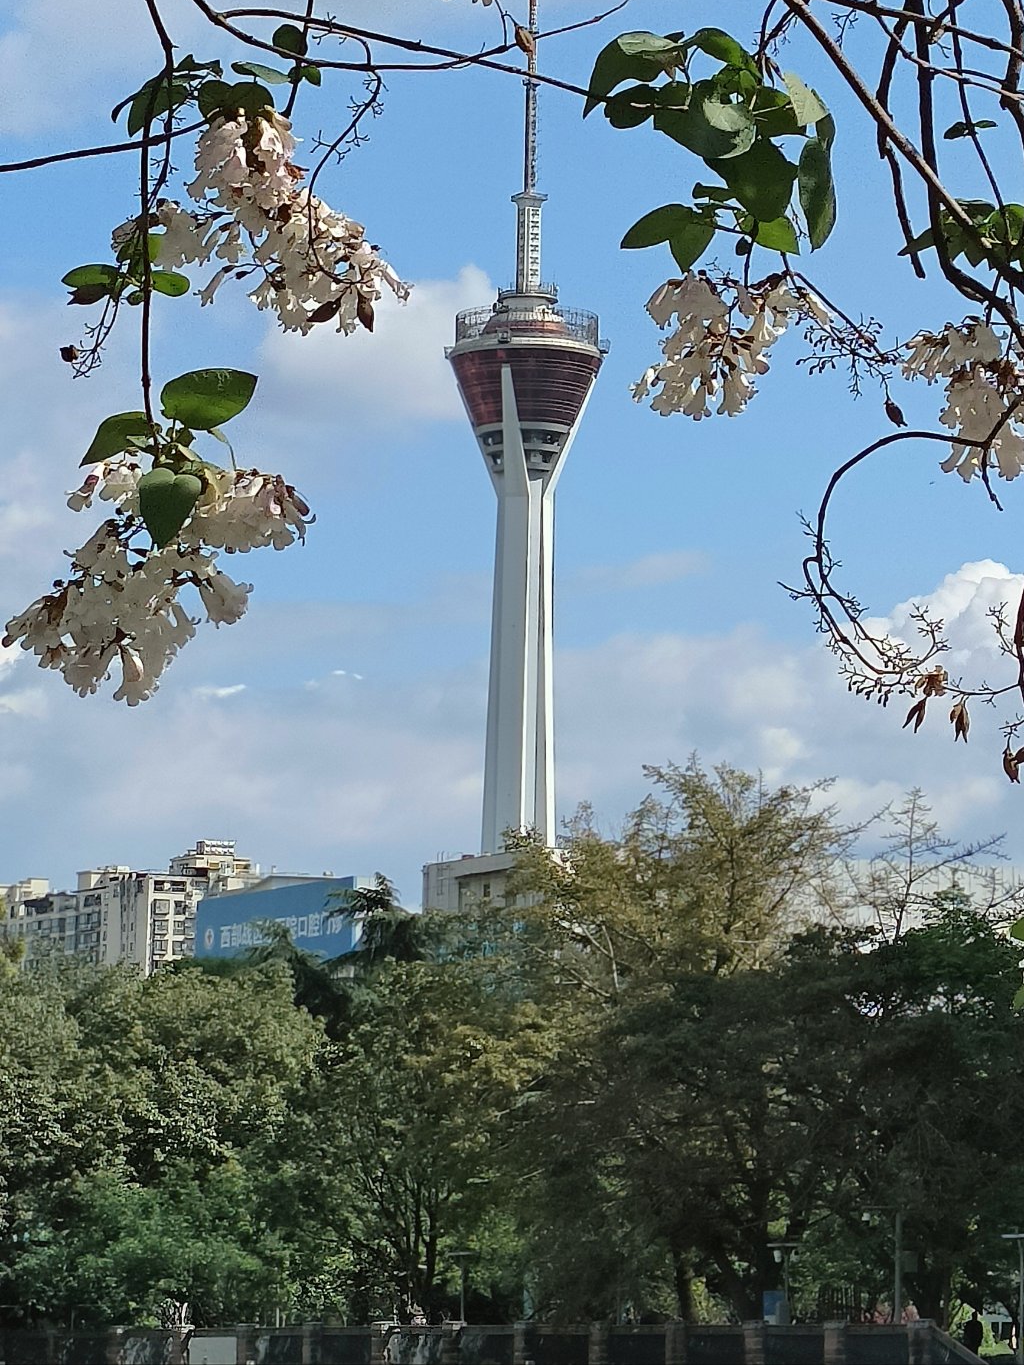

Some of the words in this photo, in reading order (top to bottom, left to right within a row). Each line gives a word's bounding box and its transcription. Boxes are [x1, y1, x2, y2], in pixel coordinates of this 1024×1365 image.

[220, 911, 344, 948] 西部战区院口腔门诊
